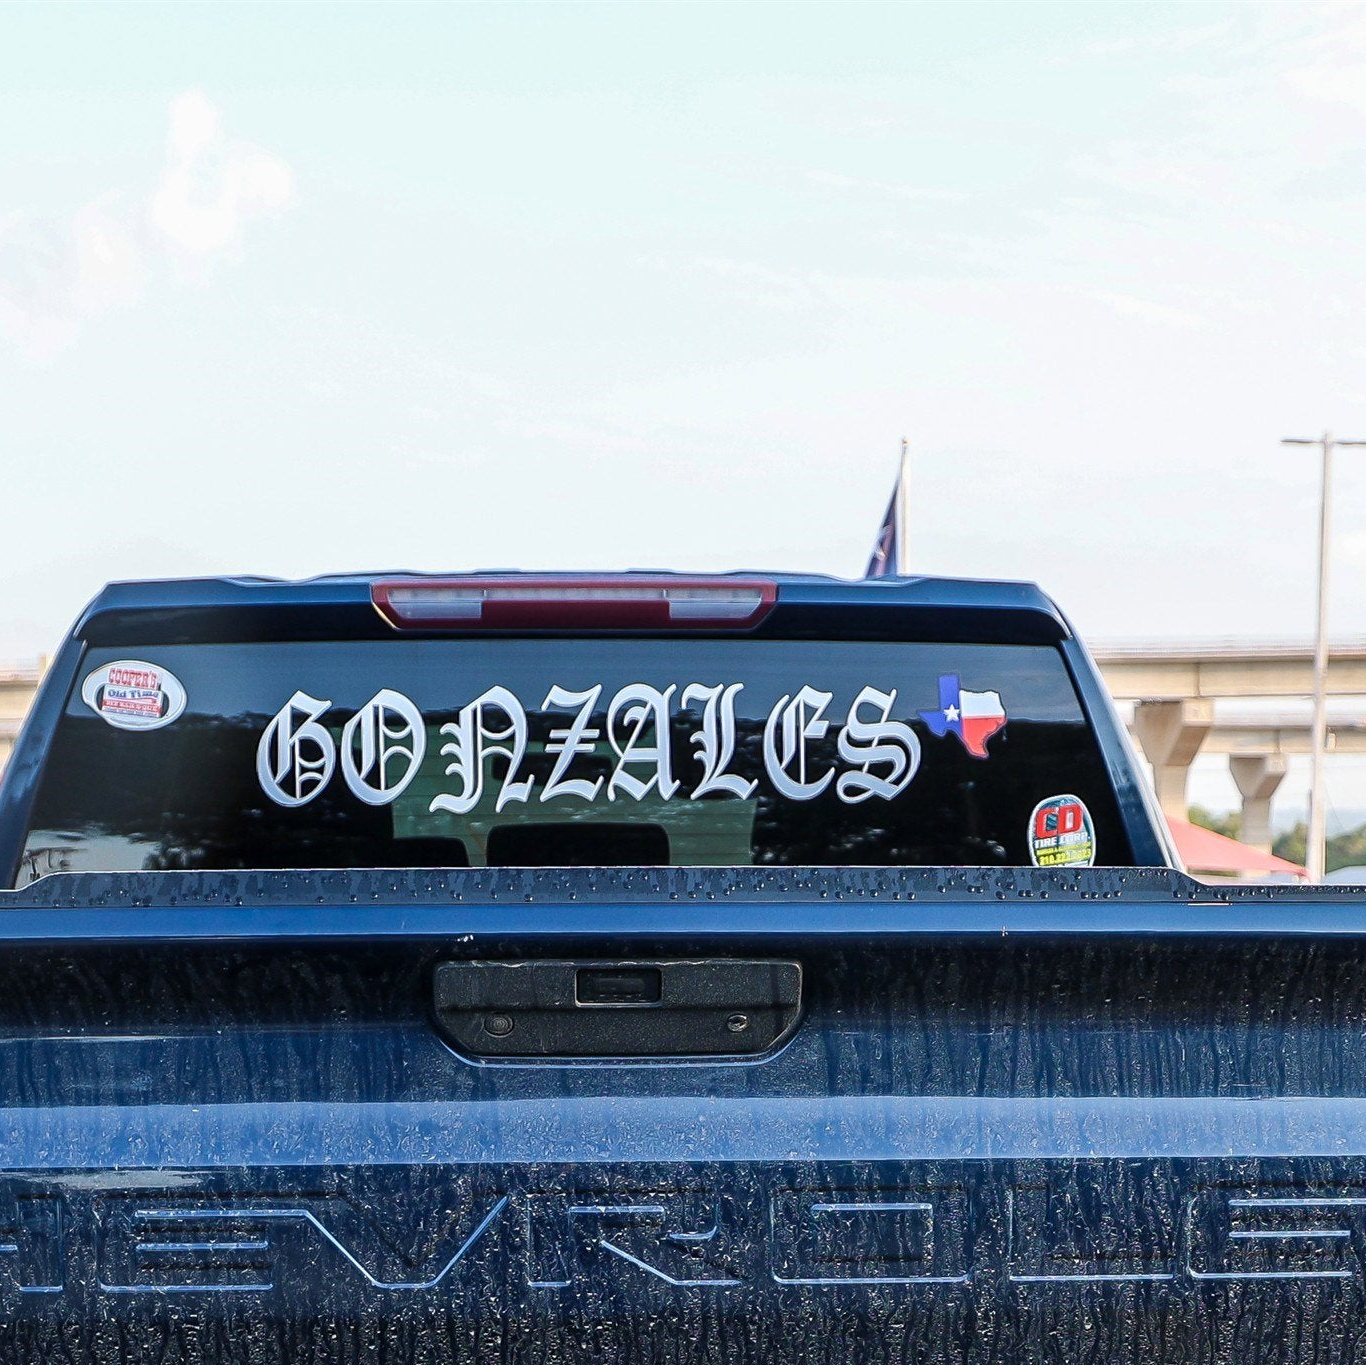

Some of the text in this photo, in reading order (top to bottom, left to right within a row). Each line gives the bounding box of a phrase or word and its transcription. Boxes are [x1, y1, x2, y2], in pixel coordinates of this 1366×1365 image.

[107, 690, 159, 699] Old Time
[256, 682, 922, 814] GONZALES
[1036, 804, 1084, 839] CD
[1034, 836, 1058, 849] TIRE
